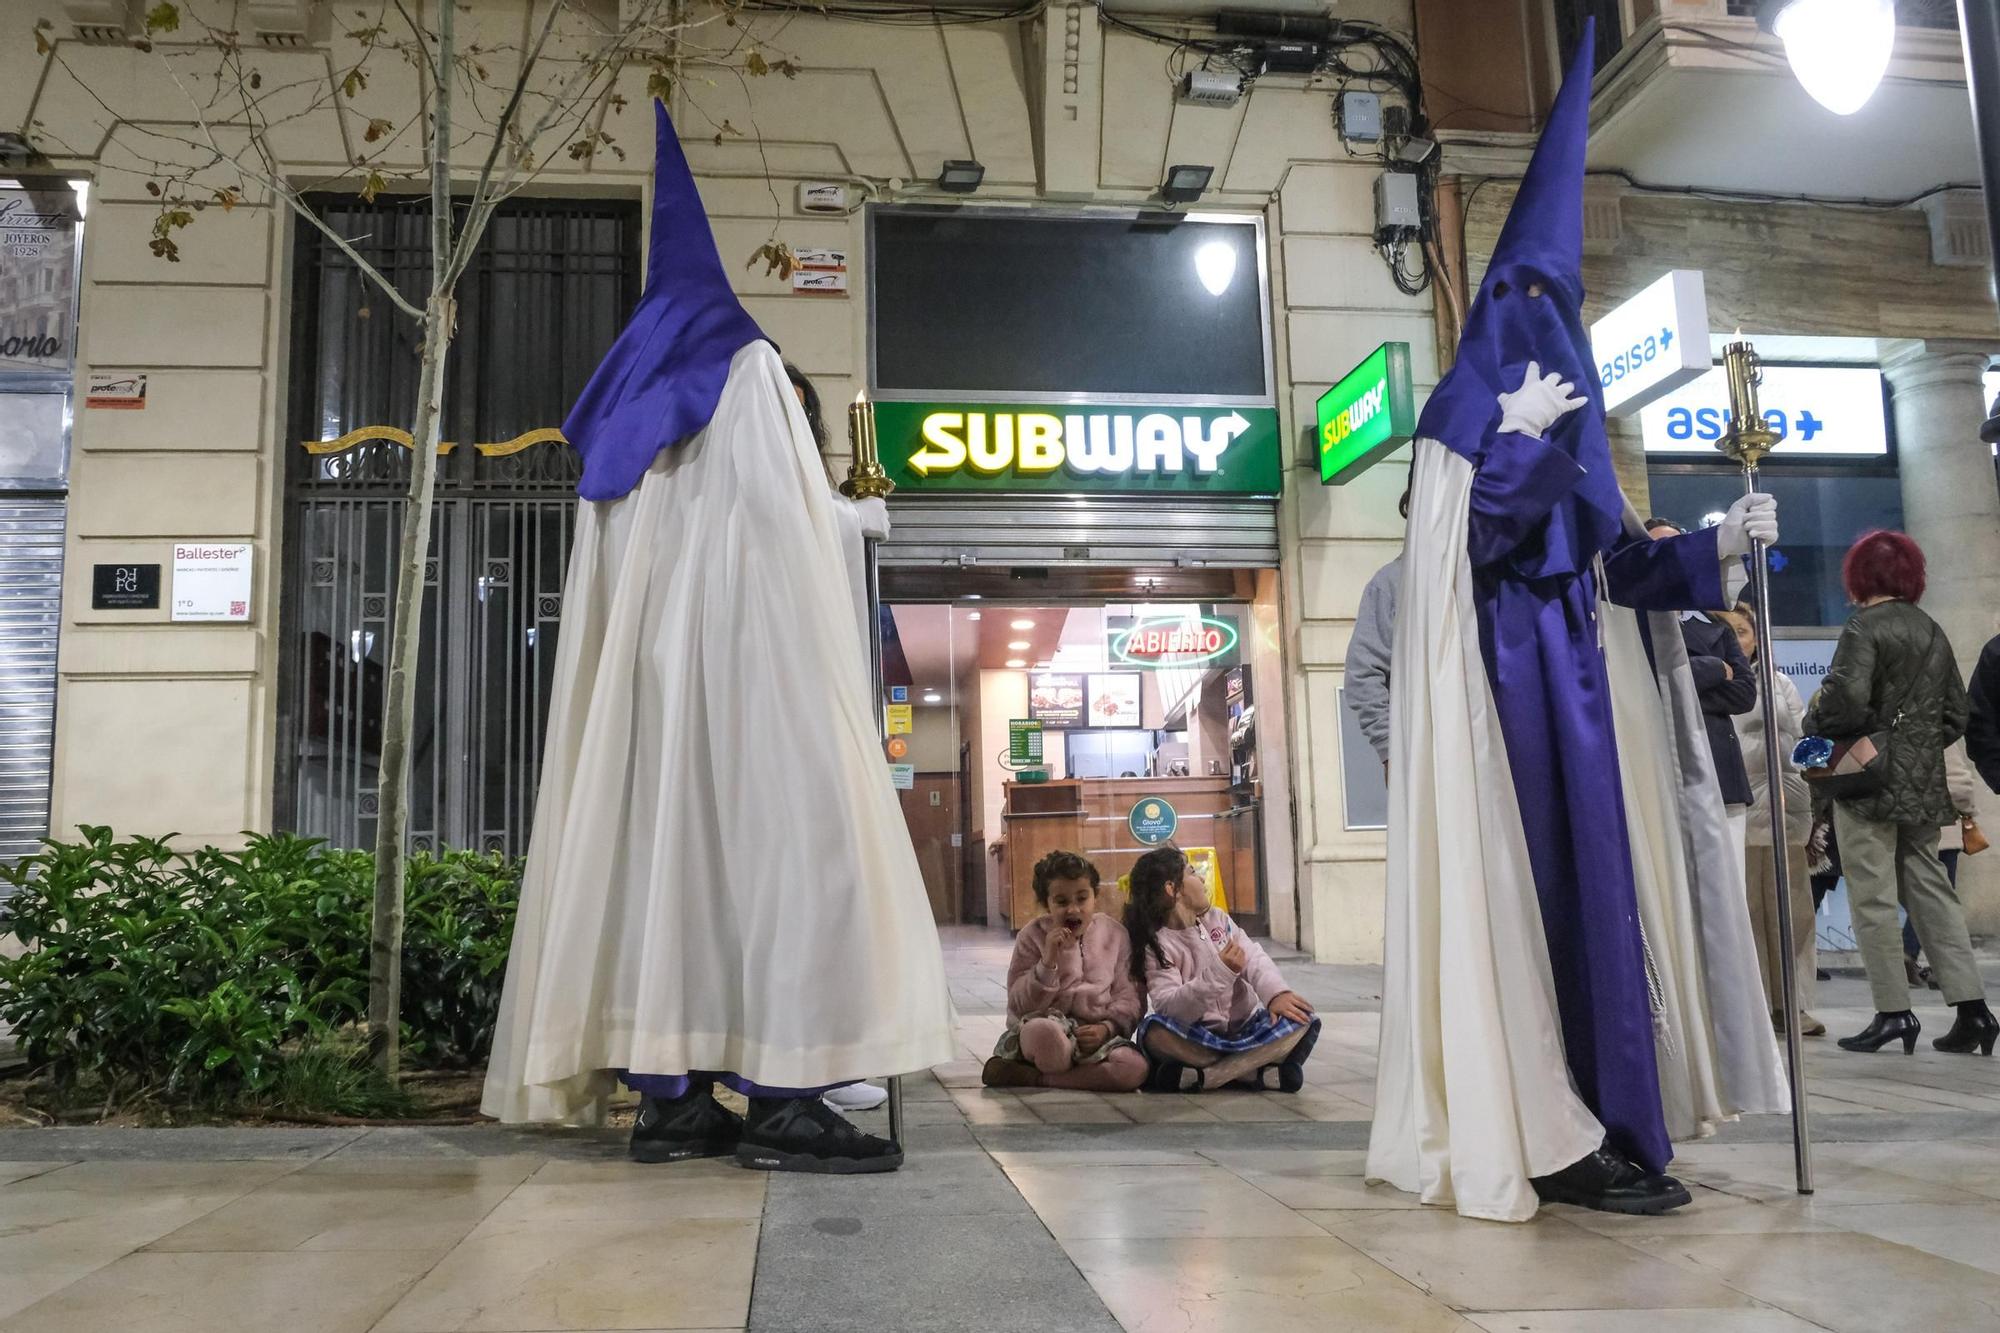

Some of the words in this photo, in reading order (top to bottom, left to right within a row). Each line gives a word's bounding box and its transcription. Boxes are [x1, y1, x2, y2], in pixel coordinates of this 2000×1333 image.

[4, 233, 51, 245] JOYEROS
[14, 247, 39, 256] 1928
[0, 333, 62, 358] ario
[1601, 336, 1657, 388] asisa
[1323, 378, 1386, 453] SUBWAY
[1667, 407, 1788, 440] asa
[908, 410, 1251, 476] SUBWAY
[176, 547, 240, 560] Ballester
[1130, 630, 1221, 653] ABIERTO
[1777, 661, 1833, 676] quilida
